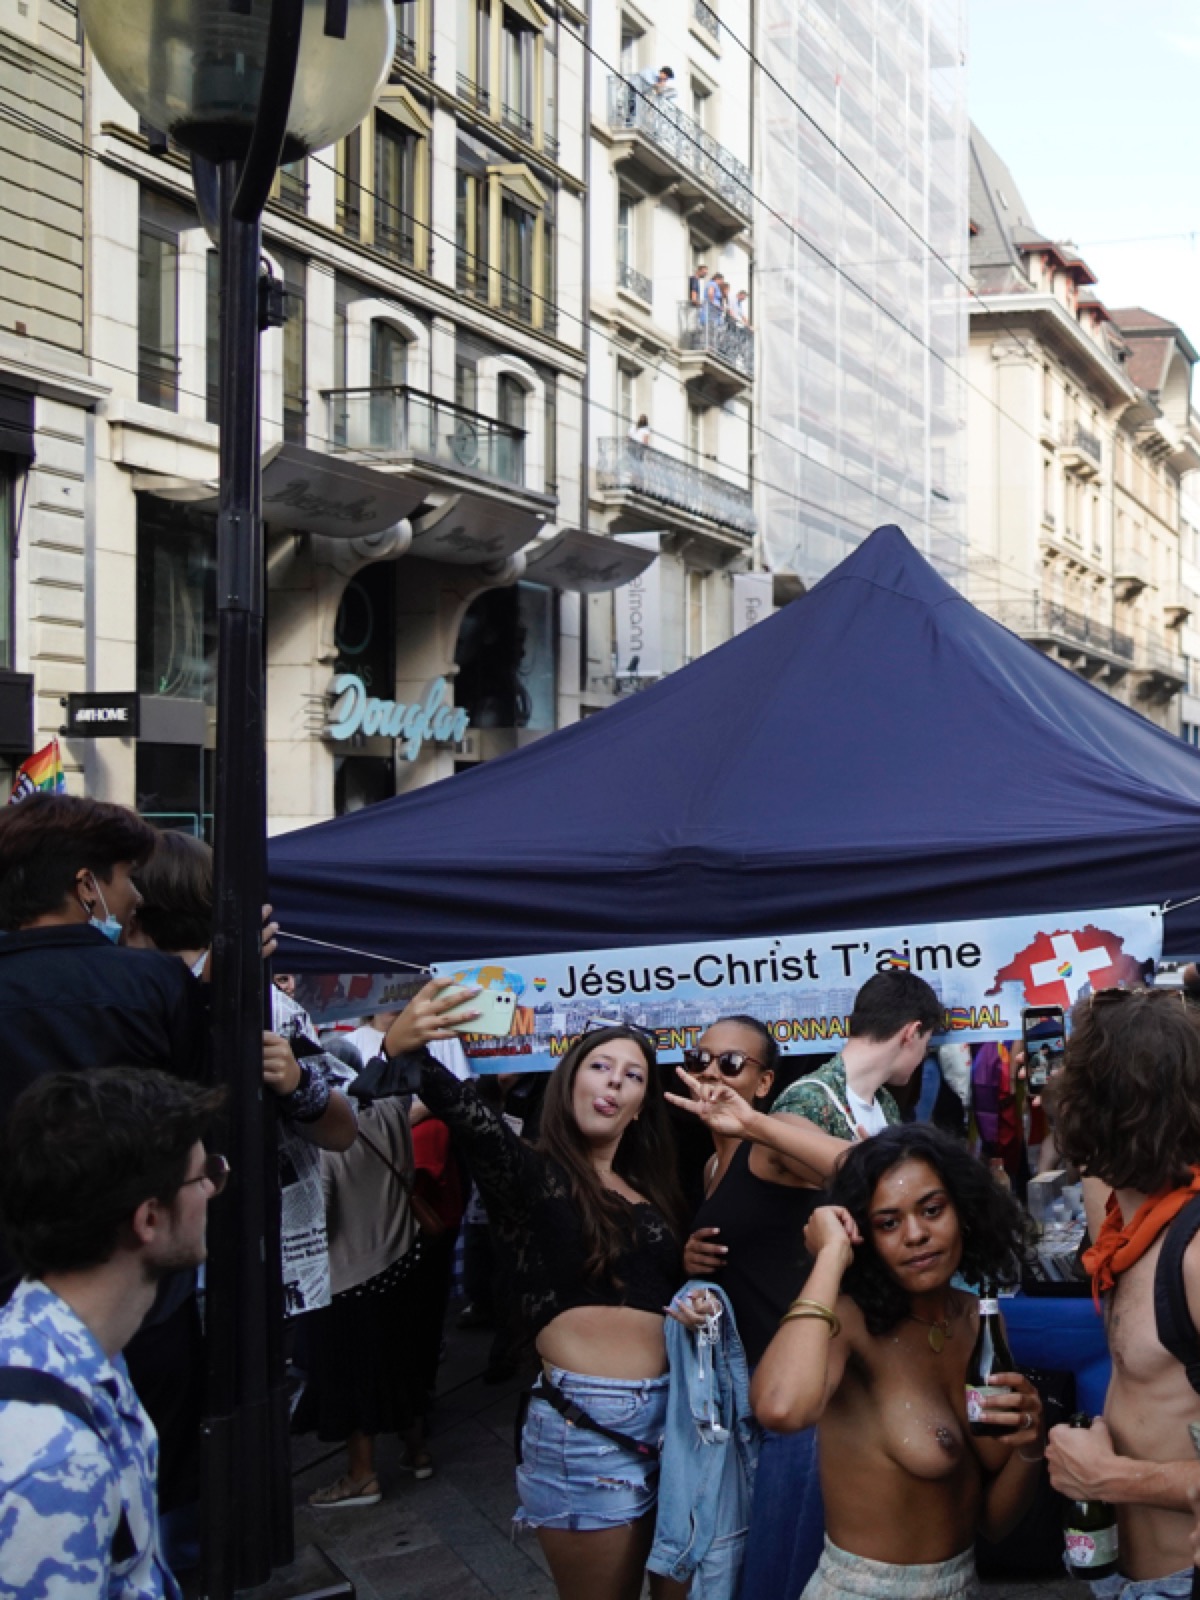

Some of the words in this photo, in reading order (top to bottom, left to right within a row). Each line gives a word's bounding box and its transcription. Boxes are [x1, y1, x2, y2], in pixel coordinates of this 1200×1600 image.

[628, 574, 646, 651] elmann
[326, 673, 470, 762] Douglas
[557, 948, 819, 998] Jésus-Christ
